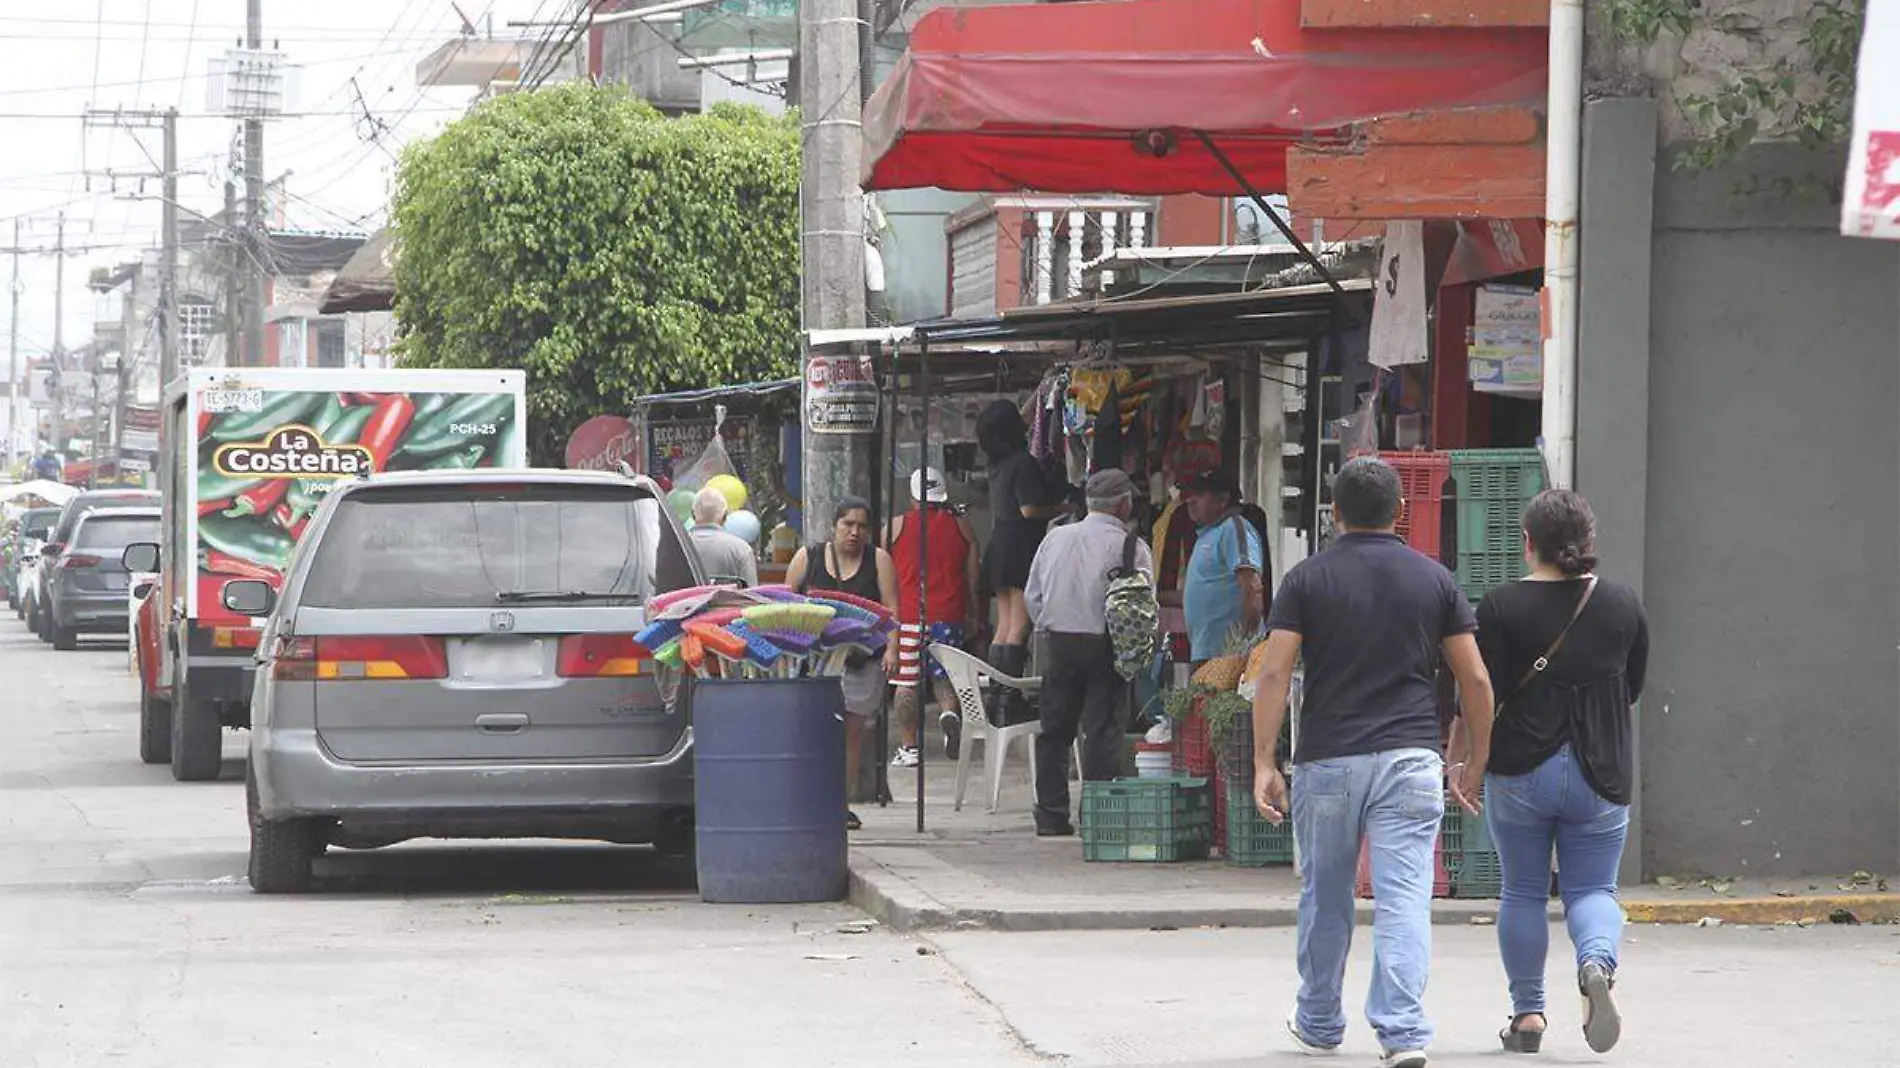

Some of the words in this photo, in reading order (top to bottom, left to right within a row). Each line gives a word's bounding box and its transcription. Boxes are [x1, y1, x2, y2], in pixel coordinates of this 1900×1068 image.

[449, 423, 497, 435] PCH-25
[653, 424, 702, 443] REGALOS
[280, 432, 308, 450] La
[228, 449, 358, 472] Costeña
